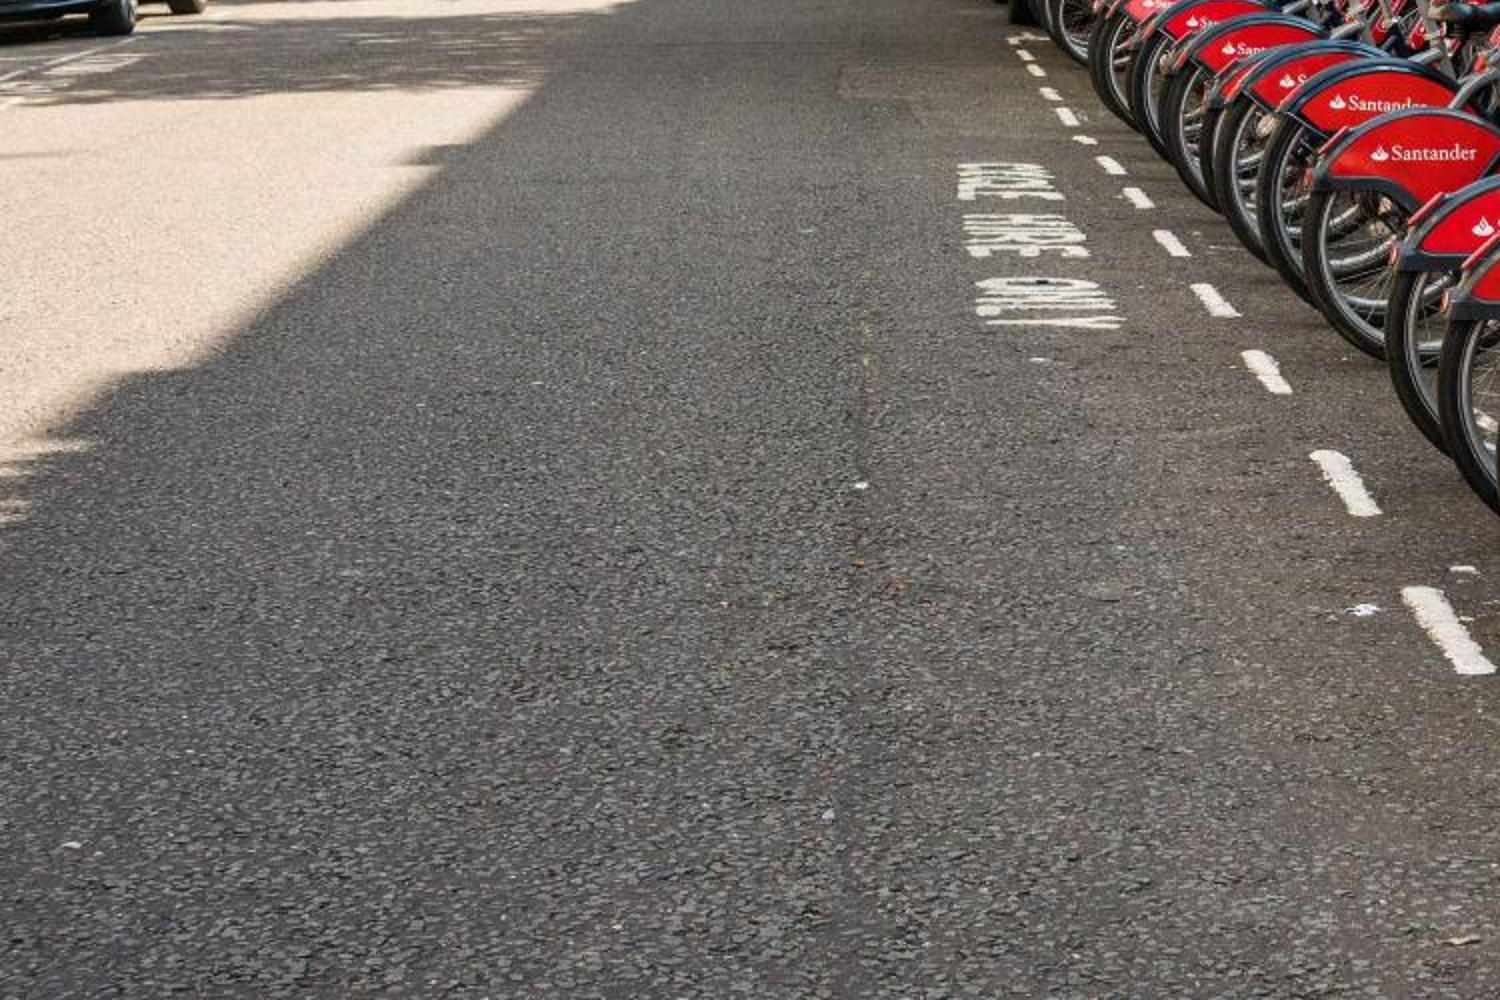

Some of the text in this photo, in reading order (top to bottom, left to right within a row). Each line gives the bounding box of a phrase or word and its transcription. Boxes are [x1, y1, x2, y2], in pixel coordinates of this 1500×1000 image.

[1390, 143, 1477, 161] Santander
[962, 213, 1092, 257] HIRE
[975, 277, 1128, 329] ONLY
